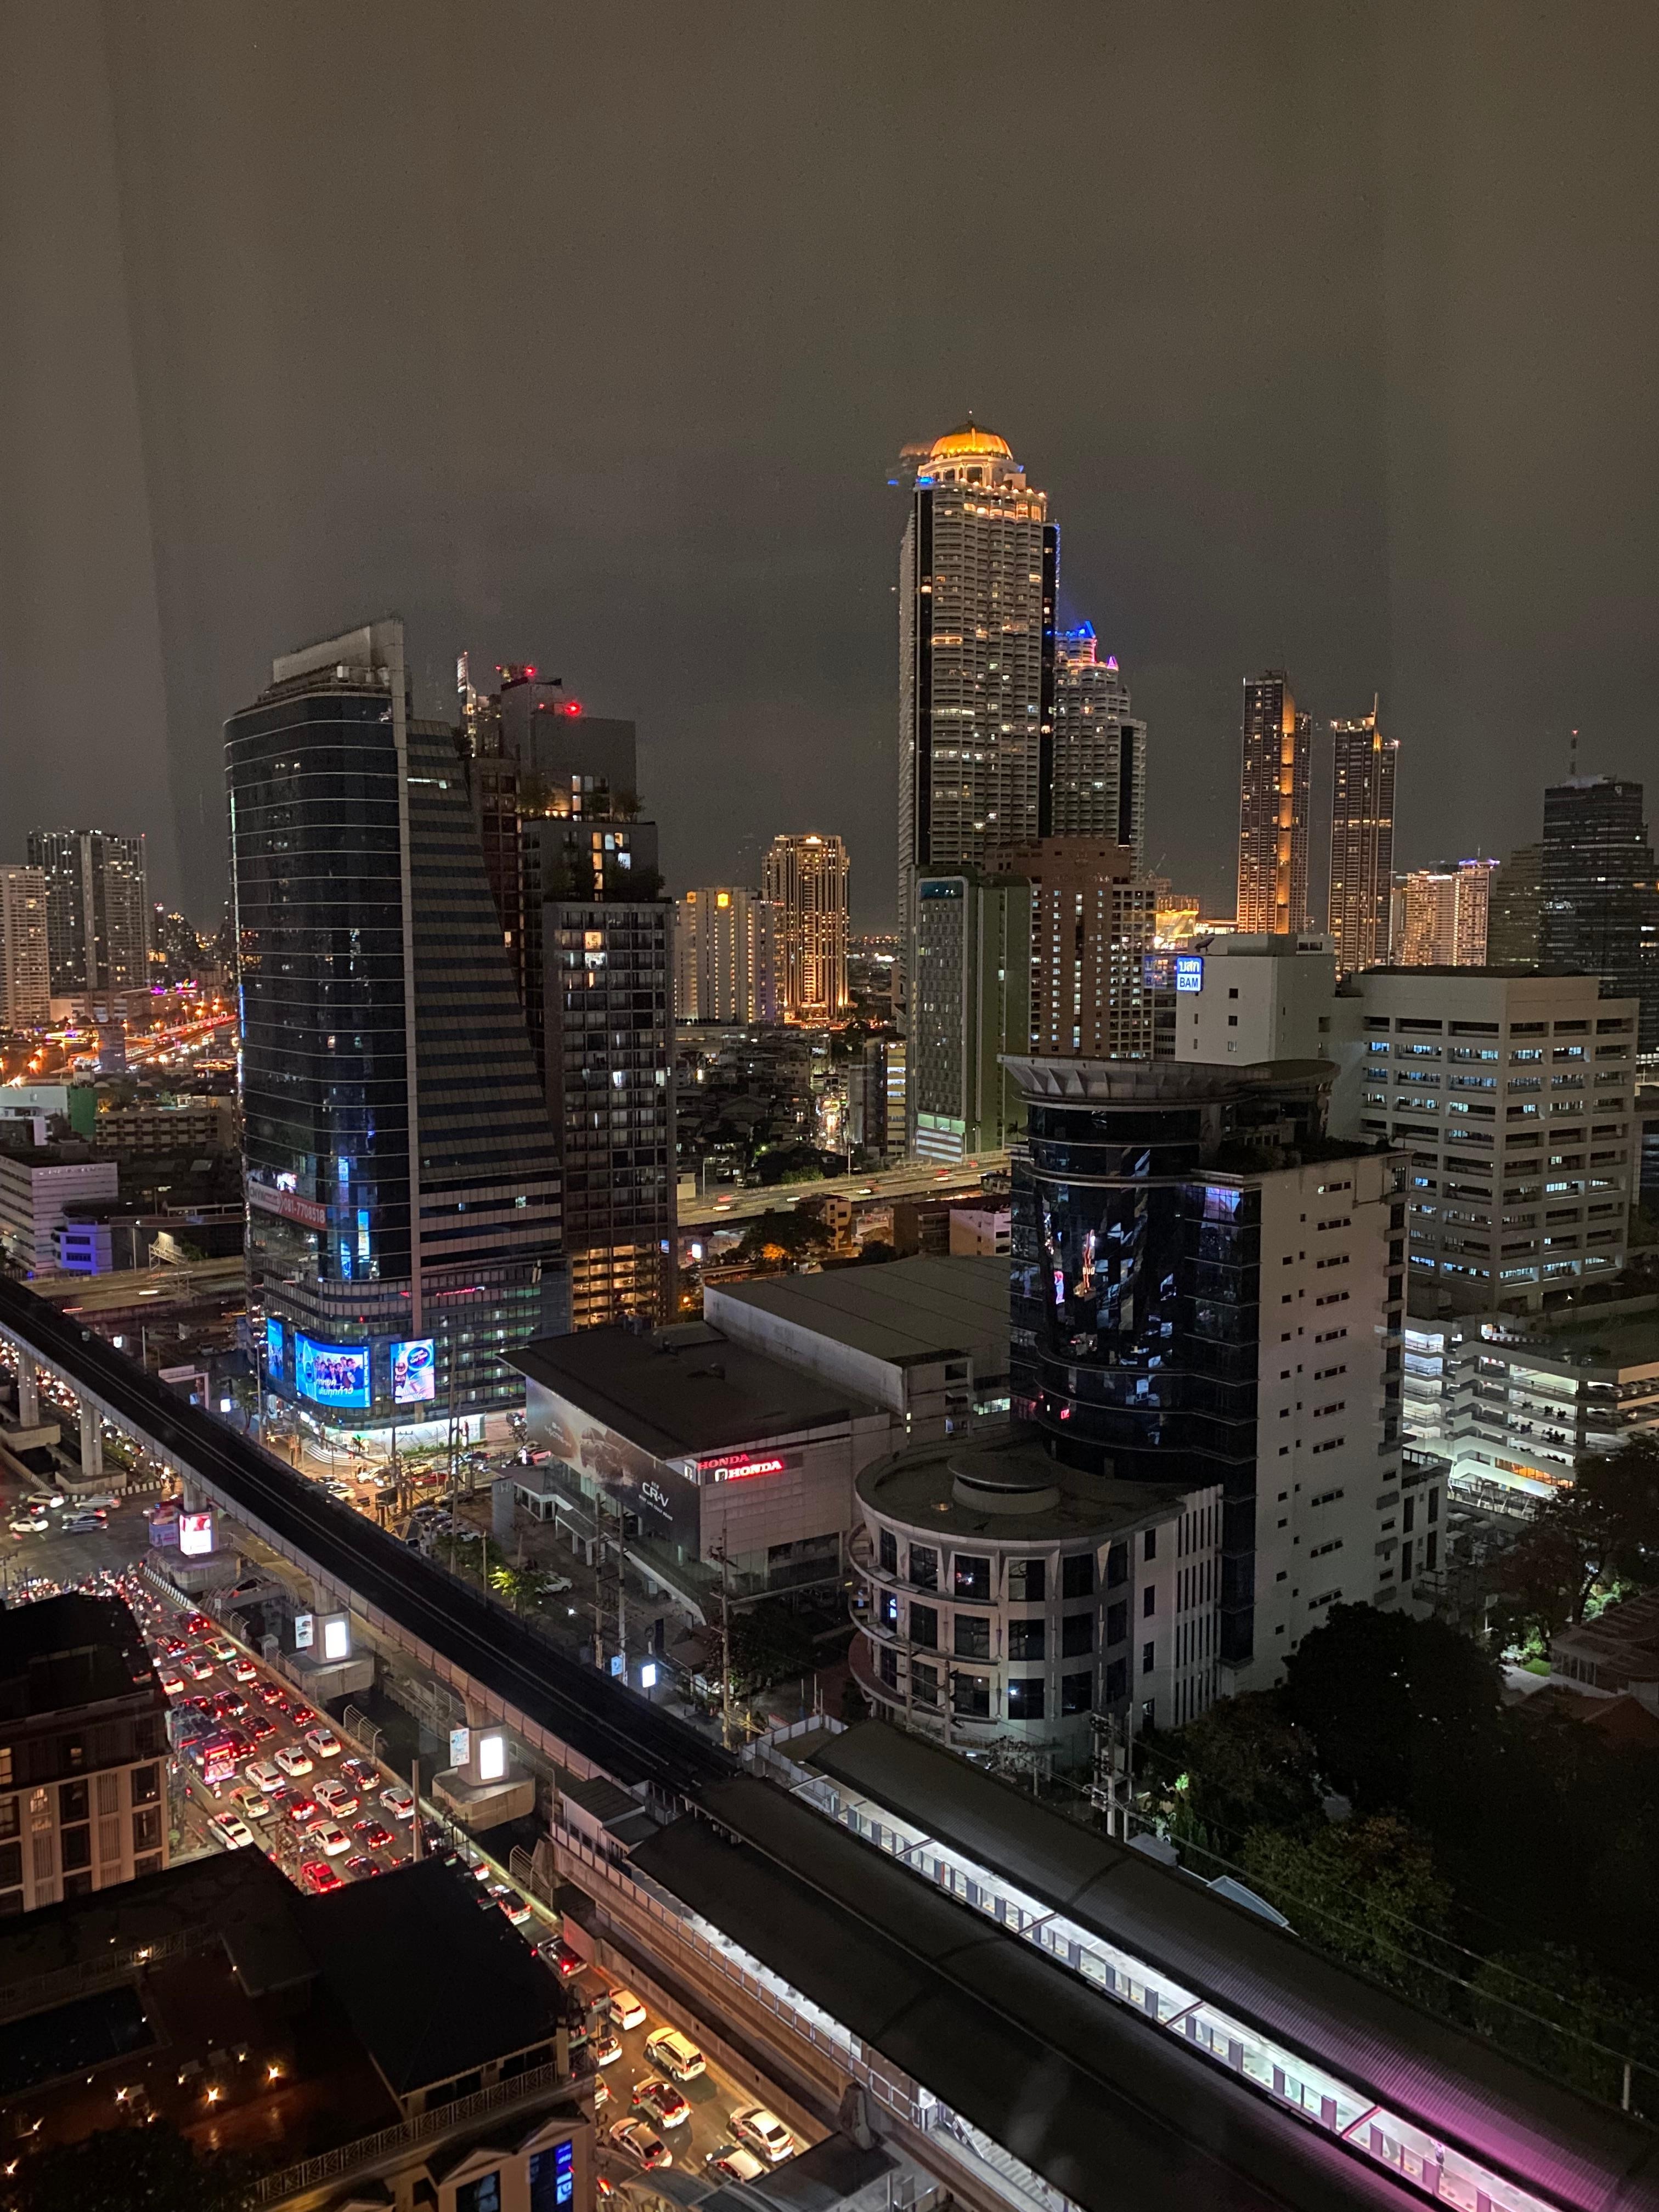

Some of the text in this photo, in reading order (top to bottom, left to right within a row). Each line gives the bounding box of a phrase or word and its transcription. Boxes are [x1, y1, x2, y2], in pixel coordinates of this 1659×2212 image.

[1179, 960, 1200, 972] บสก
[1180, 977, 1198, 988] BAM
[727, 1460, 782, 1479] HONDA
[642, 1482, 669, 1507] CR-V
